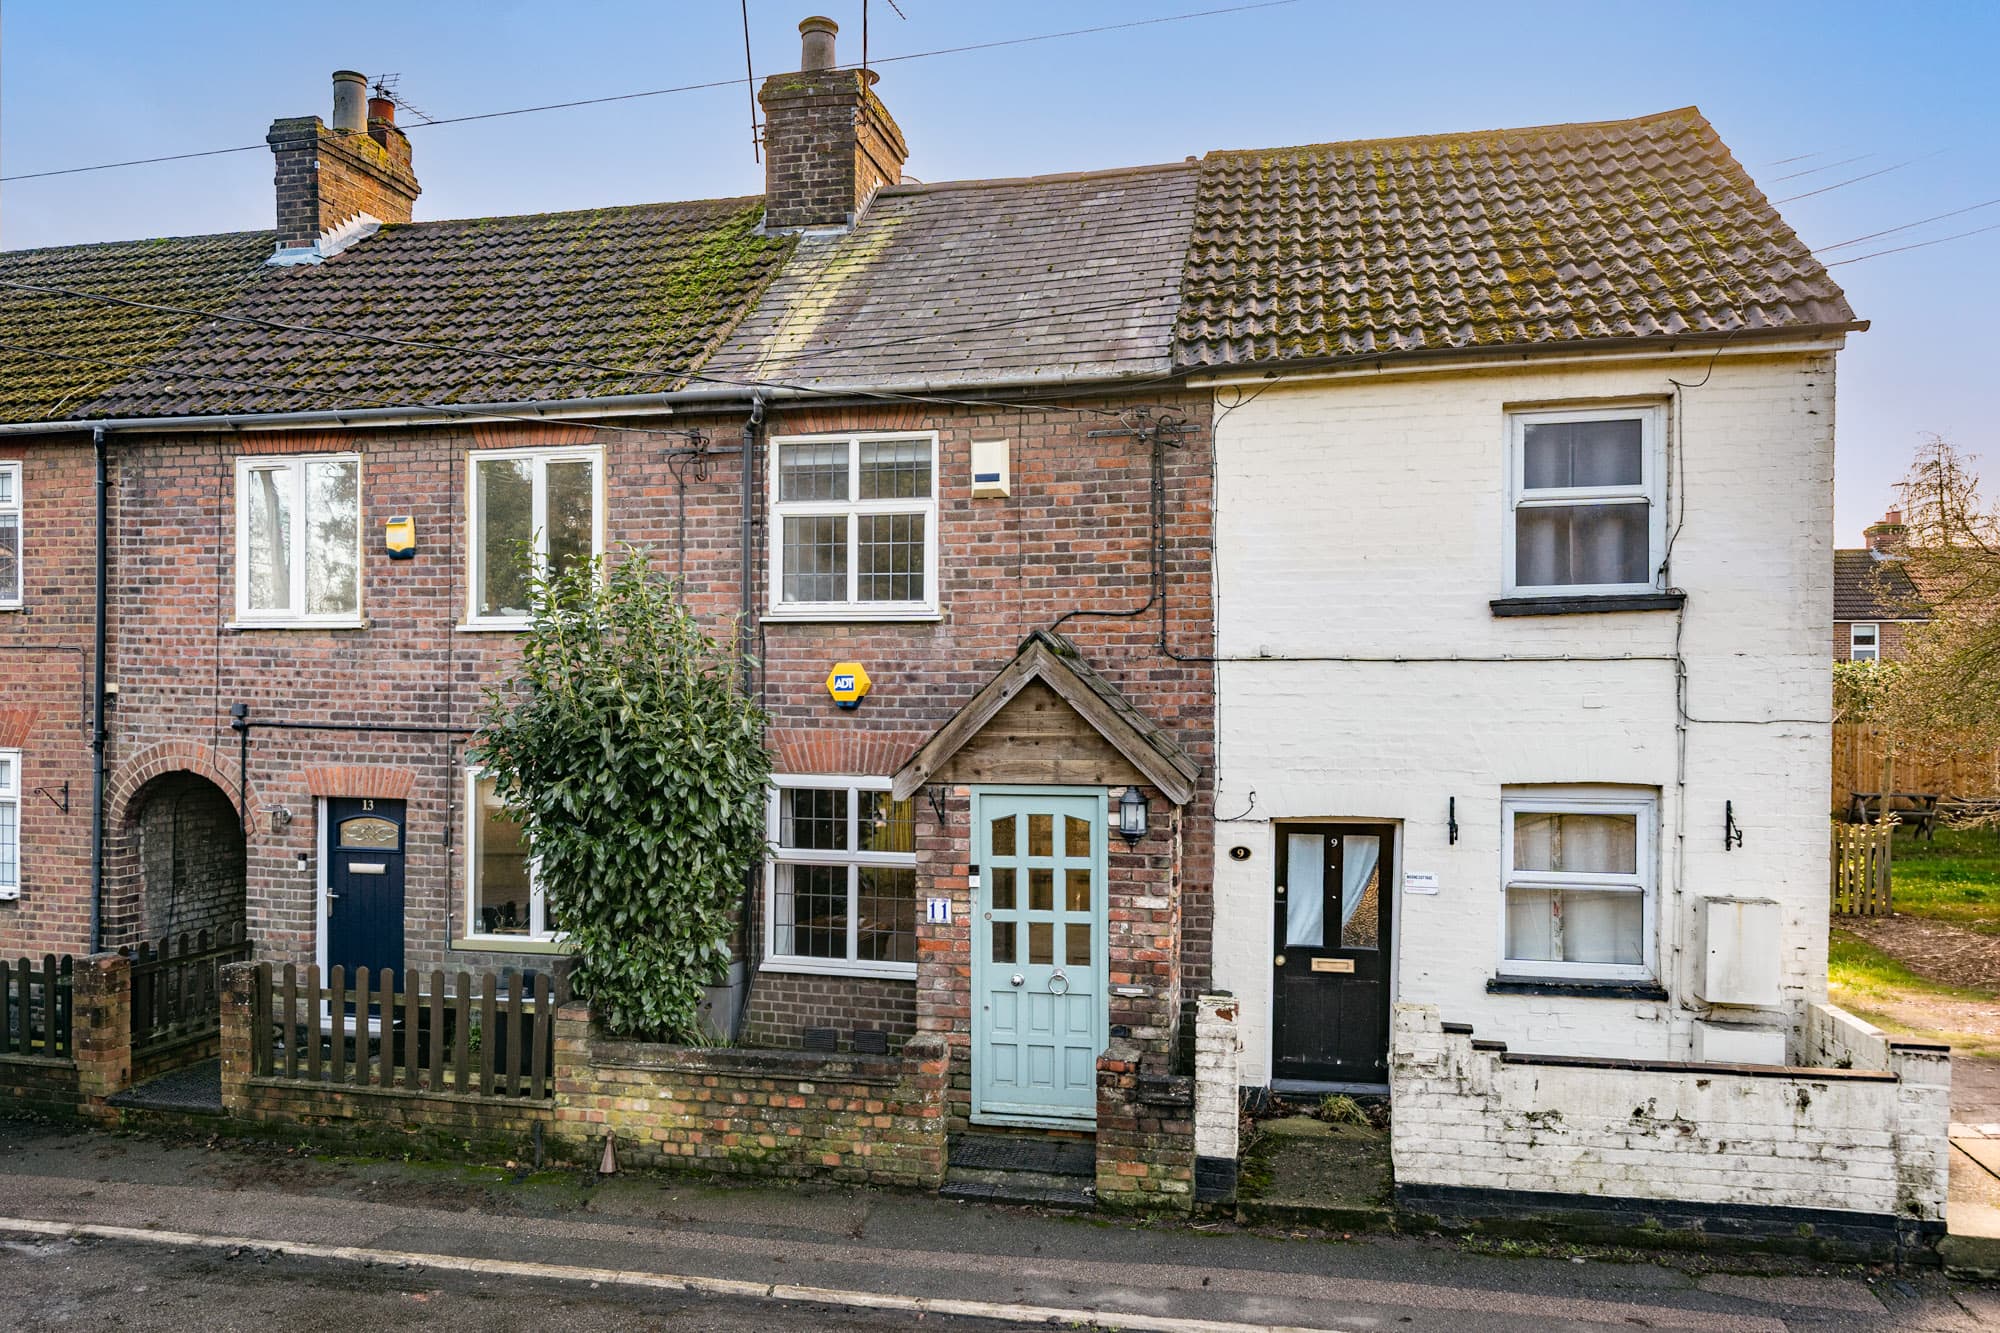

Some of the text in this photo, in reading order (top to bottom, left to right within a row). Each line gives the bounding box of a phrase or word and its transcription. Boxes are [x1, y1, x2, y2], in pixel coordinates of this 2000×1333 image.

[835, 677, 854, 689] ADT
[362, 799, 374, 811] 13
[1331, 838, 1338, 848] 9
[1237, 848, 1244, 858] 9
[930, 902, 947, 919] 11
